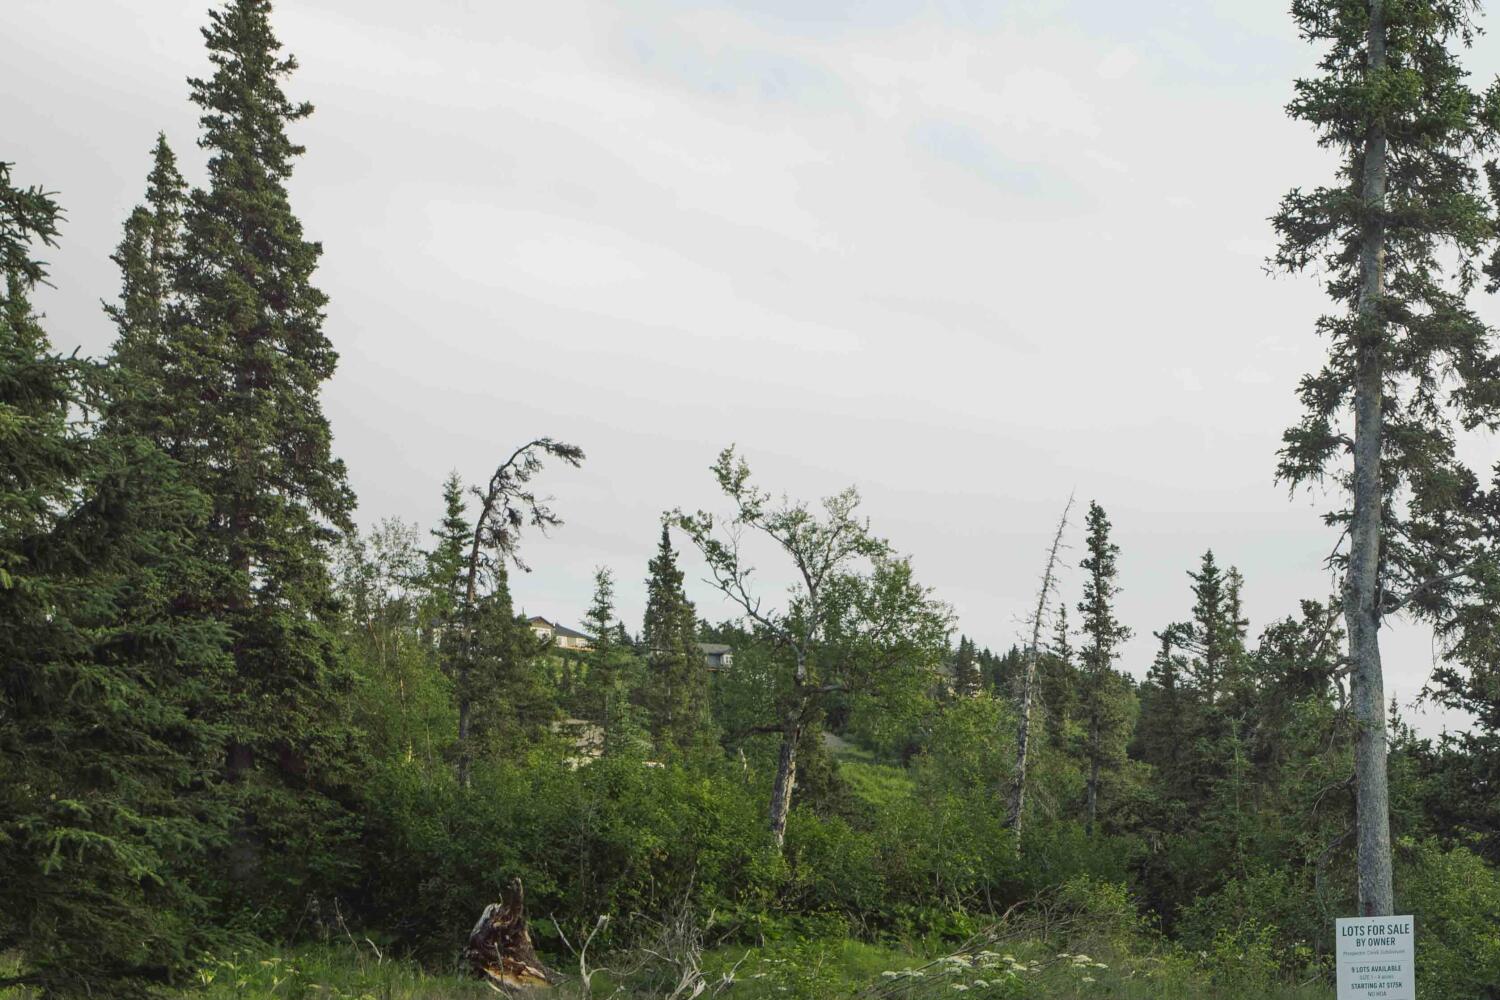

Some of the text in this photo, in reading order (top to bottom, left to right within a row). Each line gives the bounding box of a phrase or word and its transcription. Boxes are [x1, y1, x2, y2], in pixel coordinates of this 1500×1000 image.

[1342, 923, 1410, 937] LOTS FOR SALE
[1356, 937, 1396, 947] BY OWNER
[1351, 982, 1378, 990] STARTING
[1379, 981, 1385, 989] AT
